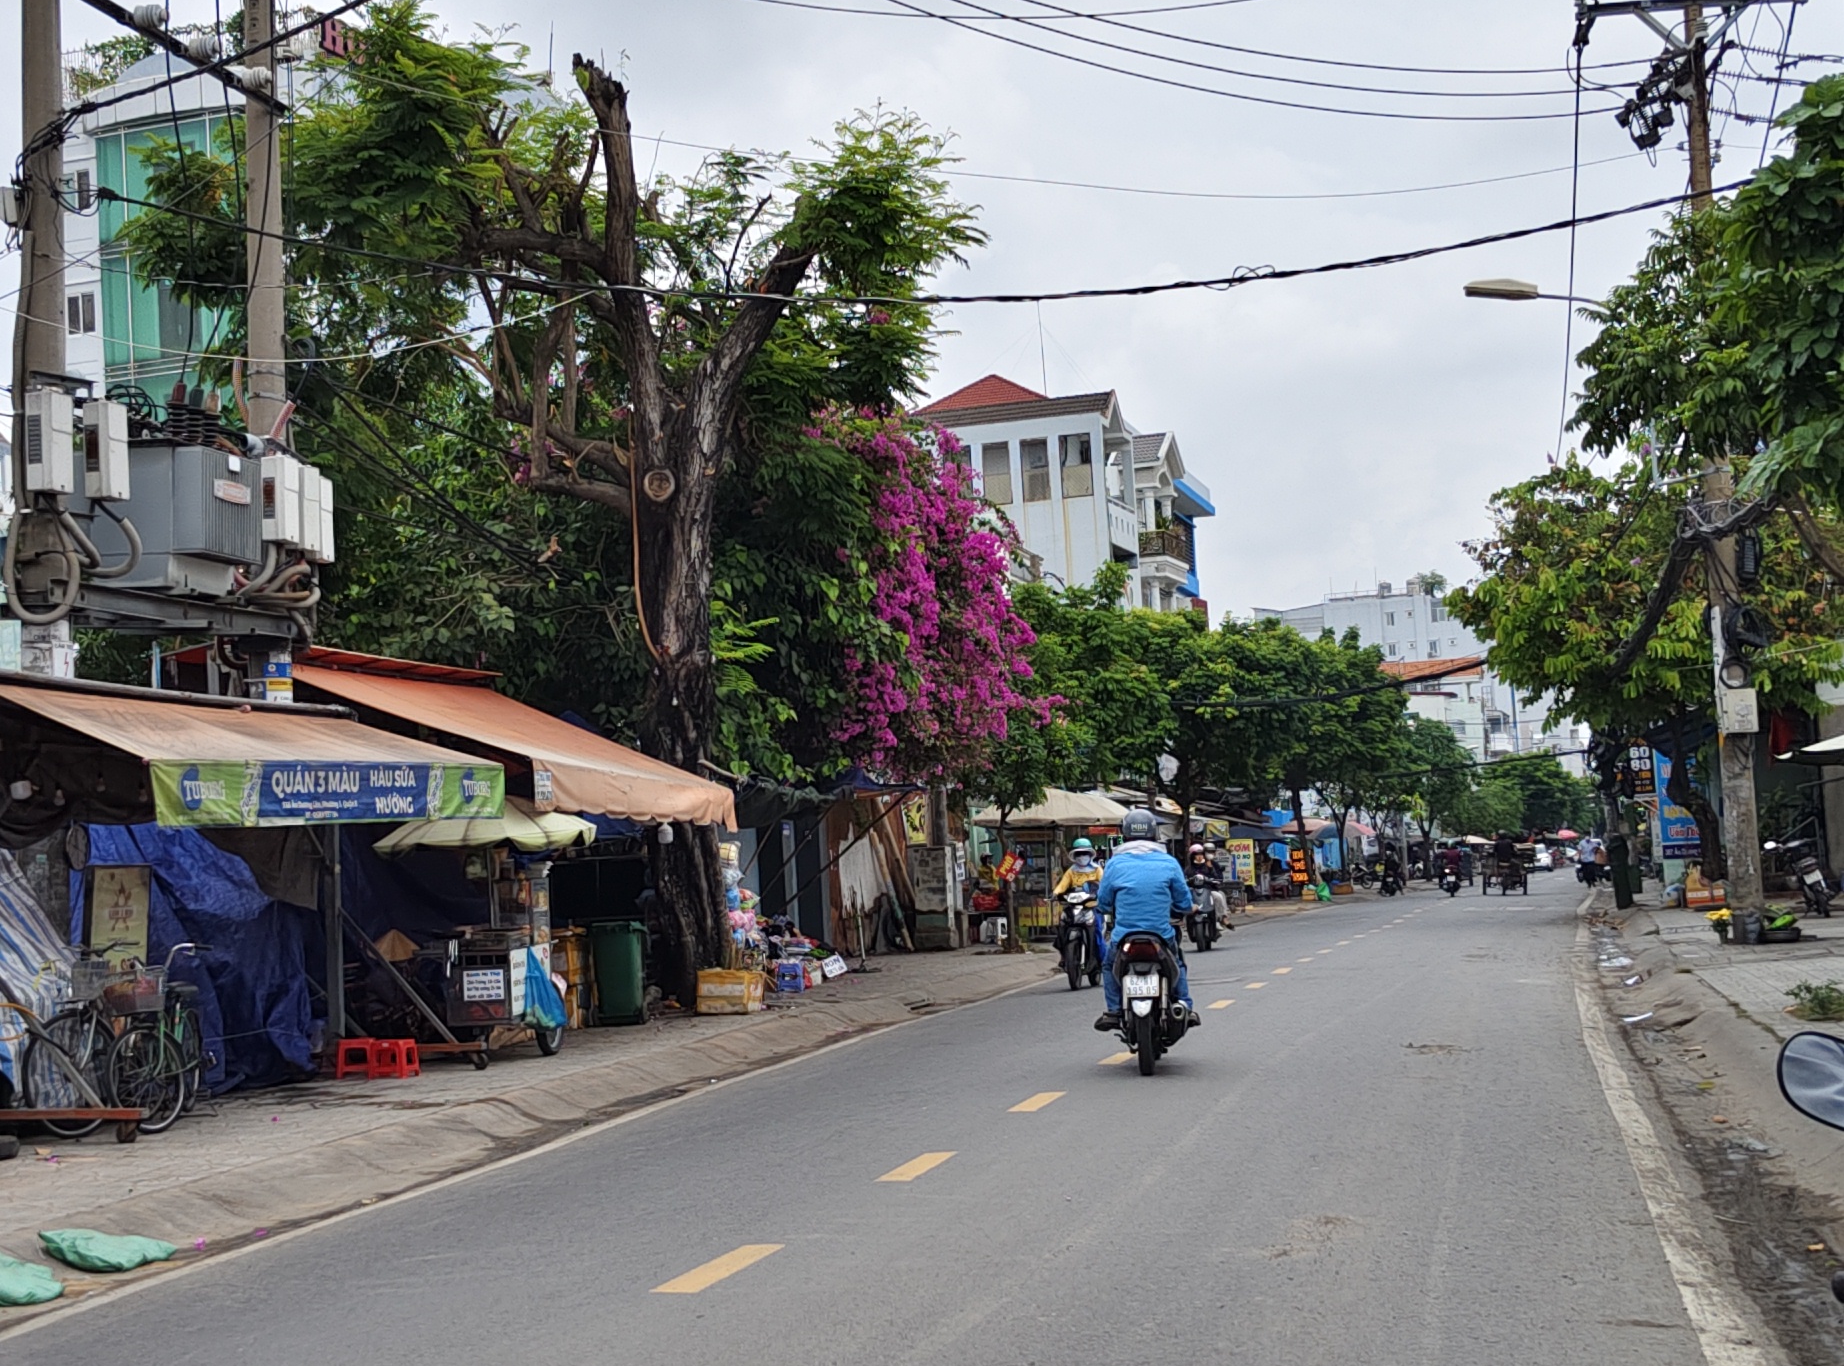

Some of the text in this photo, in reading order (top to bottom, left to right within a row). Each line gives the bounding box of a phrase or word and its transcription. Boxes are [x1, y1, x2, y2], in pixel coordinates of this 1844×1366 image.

[271, 764, 360, 798] QUÁN 3 MÀU
[370, 766, 416, 787] HÀU SỮA
[183, 780, 226, 801] TUBORG
[375, 791, 414, 814] NƯỚNG
